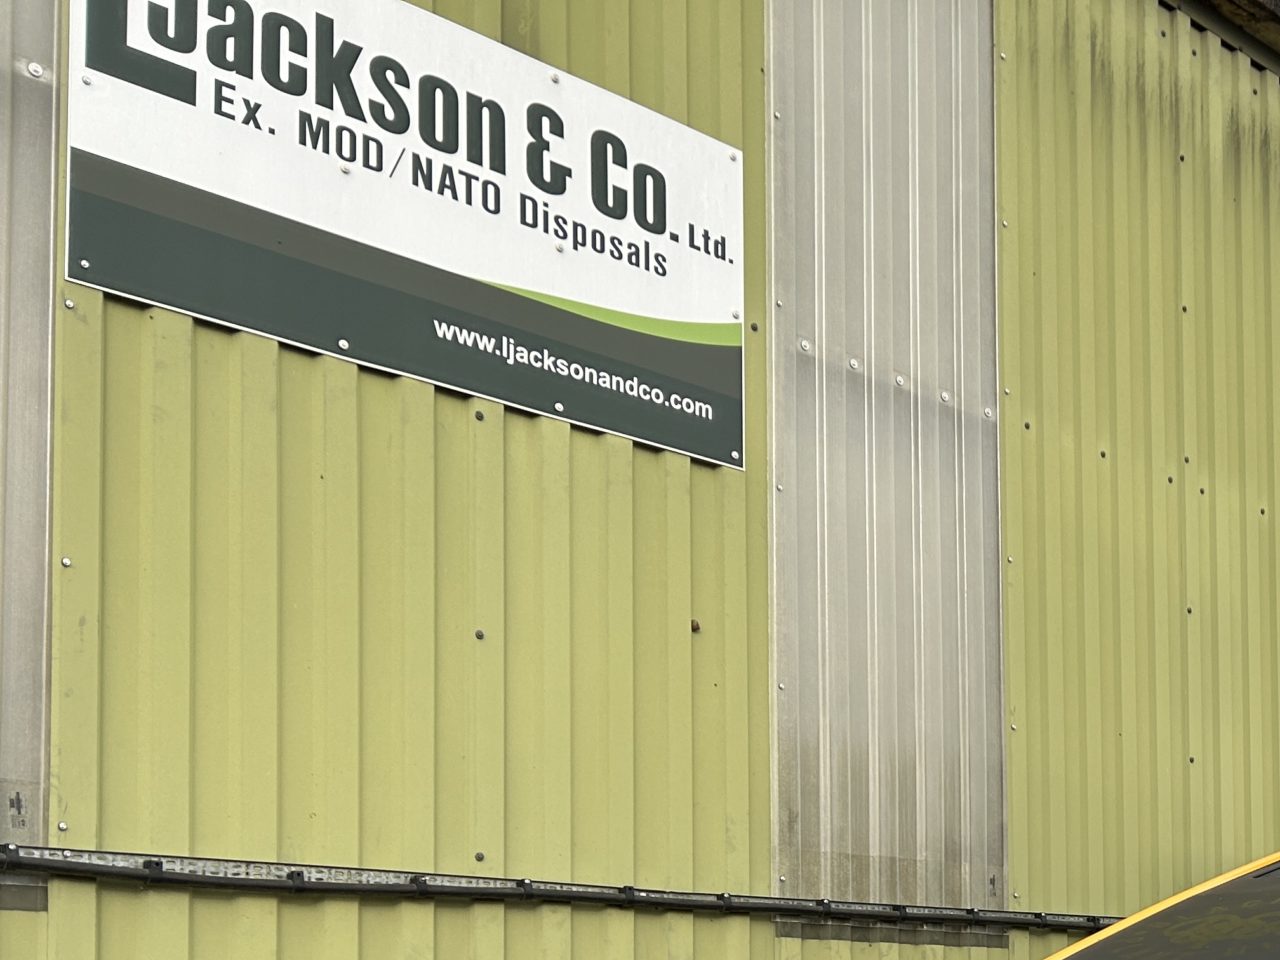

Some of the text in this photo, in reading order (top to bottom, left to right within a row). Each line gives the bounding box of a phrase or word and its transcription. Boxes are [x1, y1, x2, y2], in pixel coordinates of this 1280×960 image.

[214, 78, 276, 136] Ex.
[519, 192, 667, 277] Disposals
[526, 103, 572, 195] &
[590, 129, 679, 243] Co.
[688, 222, 734, 265] Ltd.
[433, 319, 713, 420] www.ljacksonandco.com
